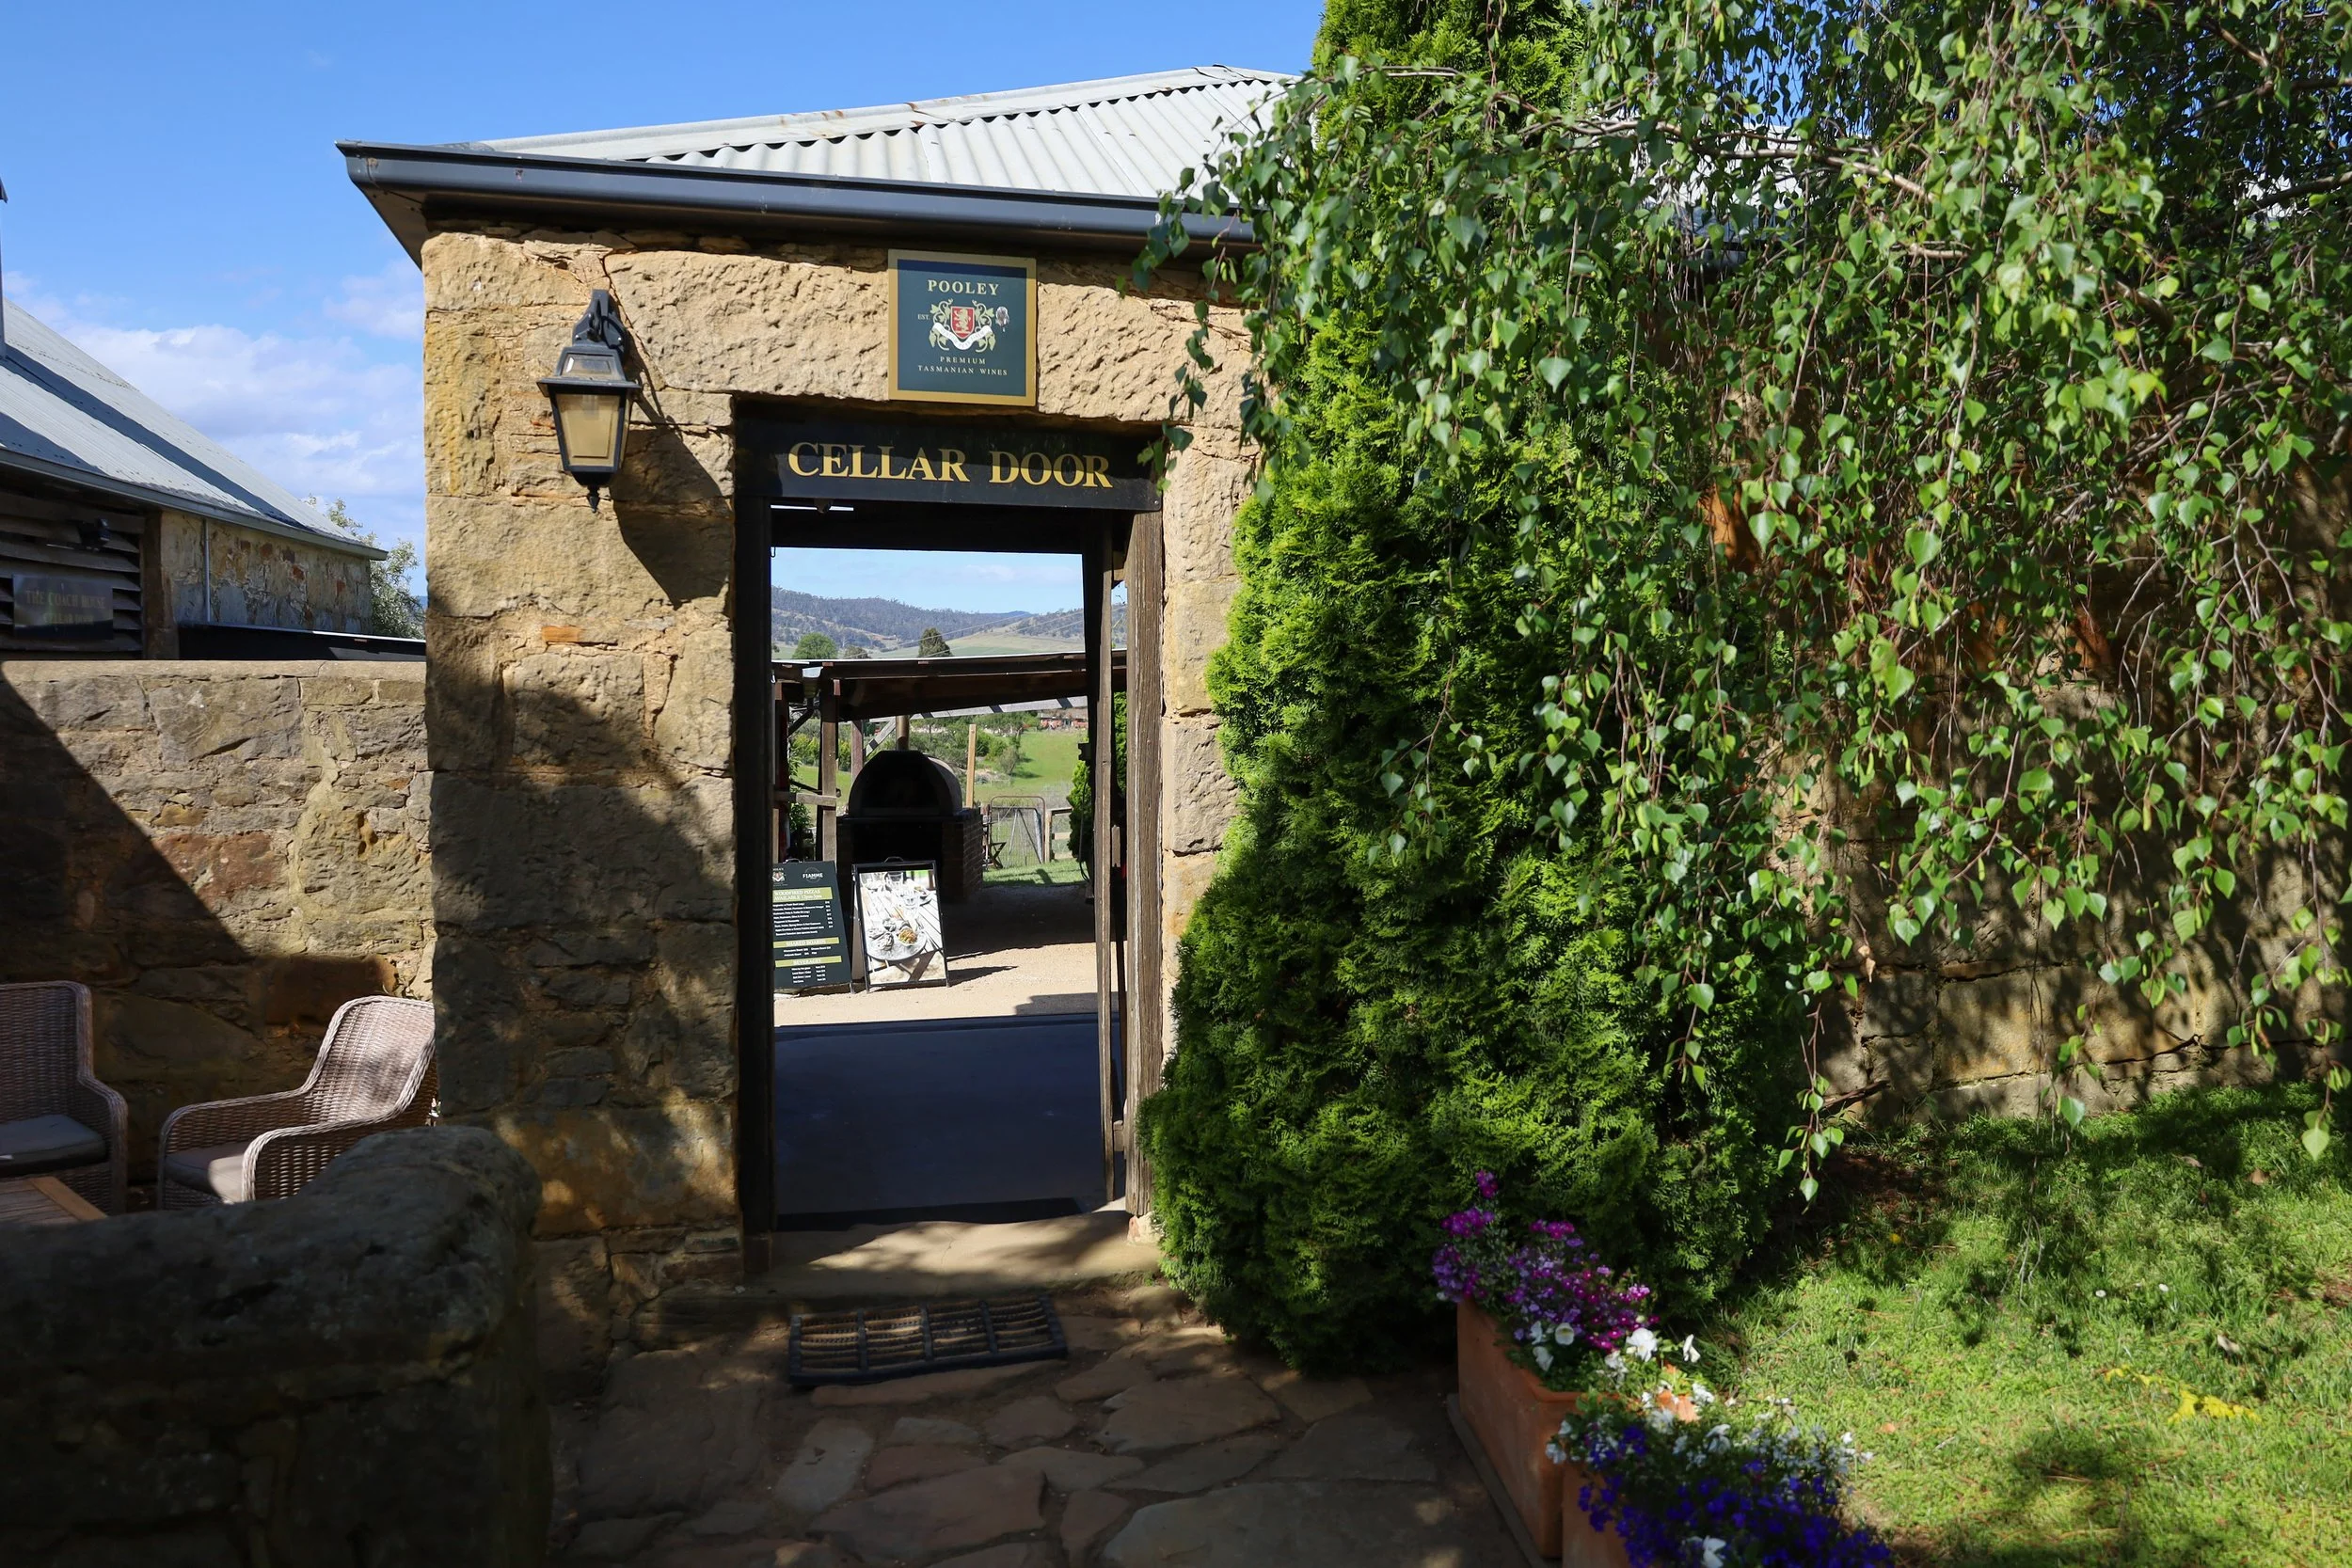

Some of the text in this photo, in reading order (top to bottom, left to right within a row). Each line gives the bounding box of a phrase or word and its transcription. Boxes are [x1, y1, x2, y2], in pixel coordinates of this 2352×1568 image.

[928, 279, 999, 295] POOLEY
[940, 356, 986, 365] PREMIUM
[917, 365, 1008, 376] TASMANIAN WINES
[787, 441, 1114, 489] CELLAR DOOR
[25, 590, 45, 605] THE
[48, 592, 78, 608] COACH
